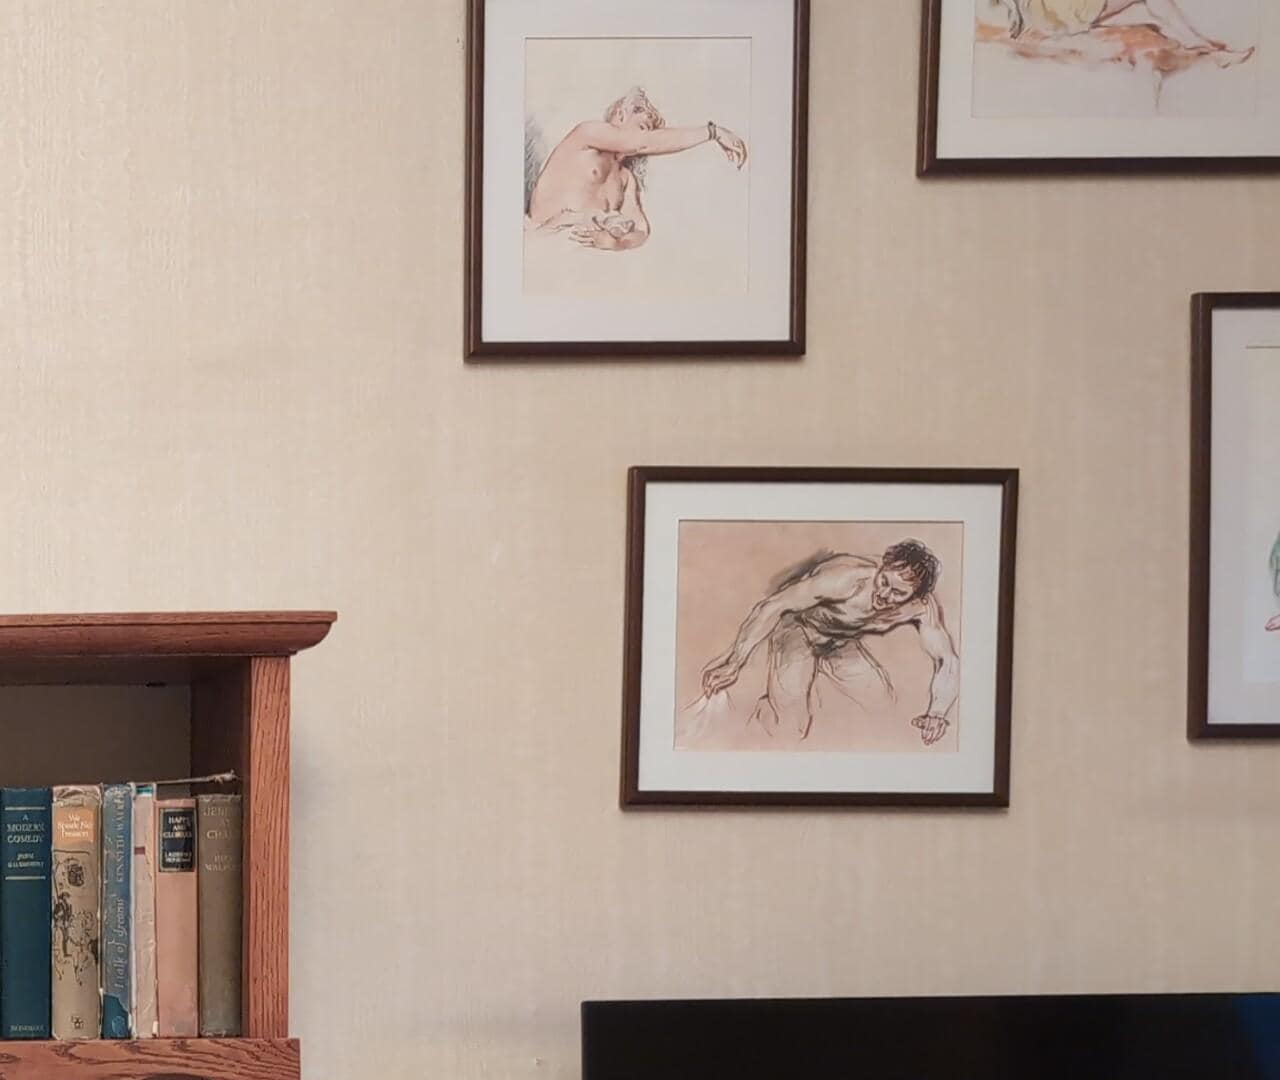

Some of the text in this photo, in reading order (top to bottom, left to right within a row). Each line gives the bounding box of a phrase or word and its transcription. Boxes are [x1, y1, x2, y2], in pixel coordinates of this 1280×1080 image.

[7, 824, 45, 832] MODERN
[7, 835, 43, 843] COMEDY
[116, 836, 124, 882] KENNETH
[114, 957, 124, 980] talk
